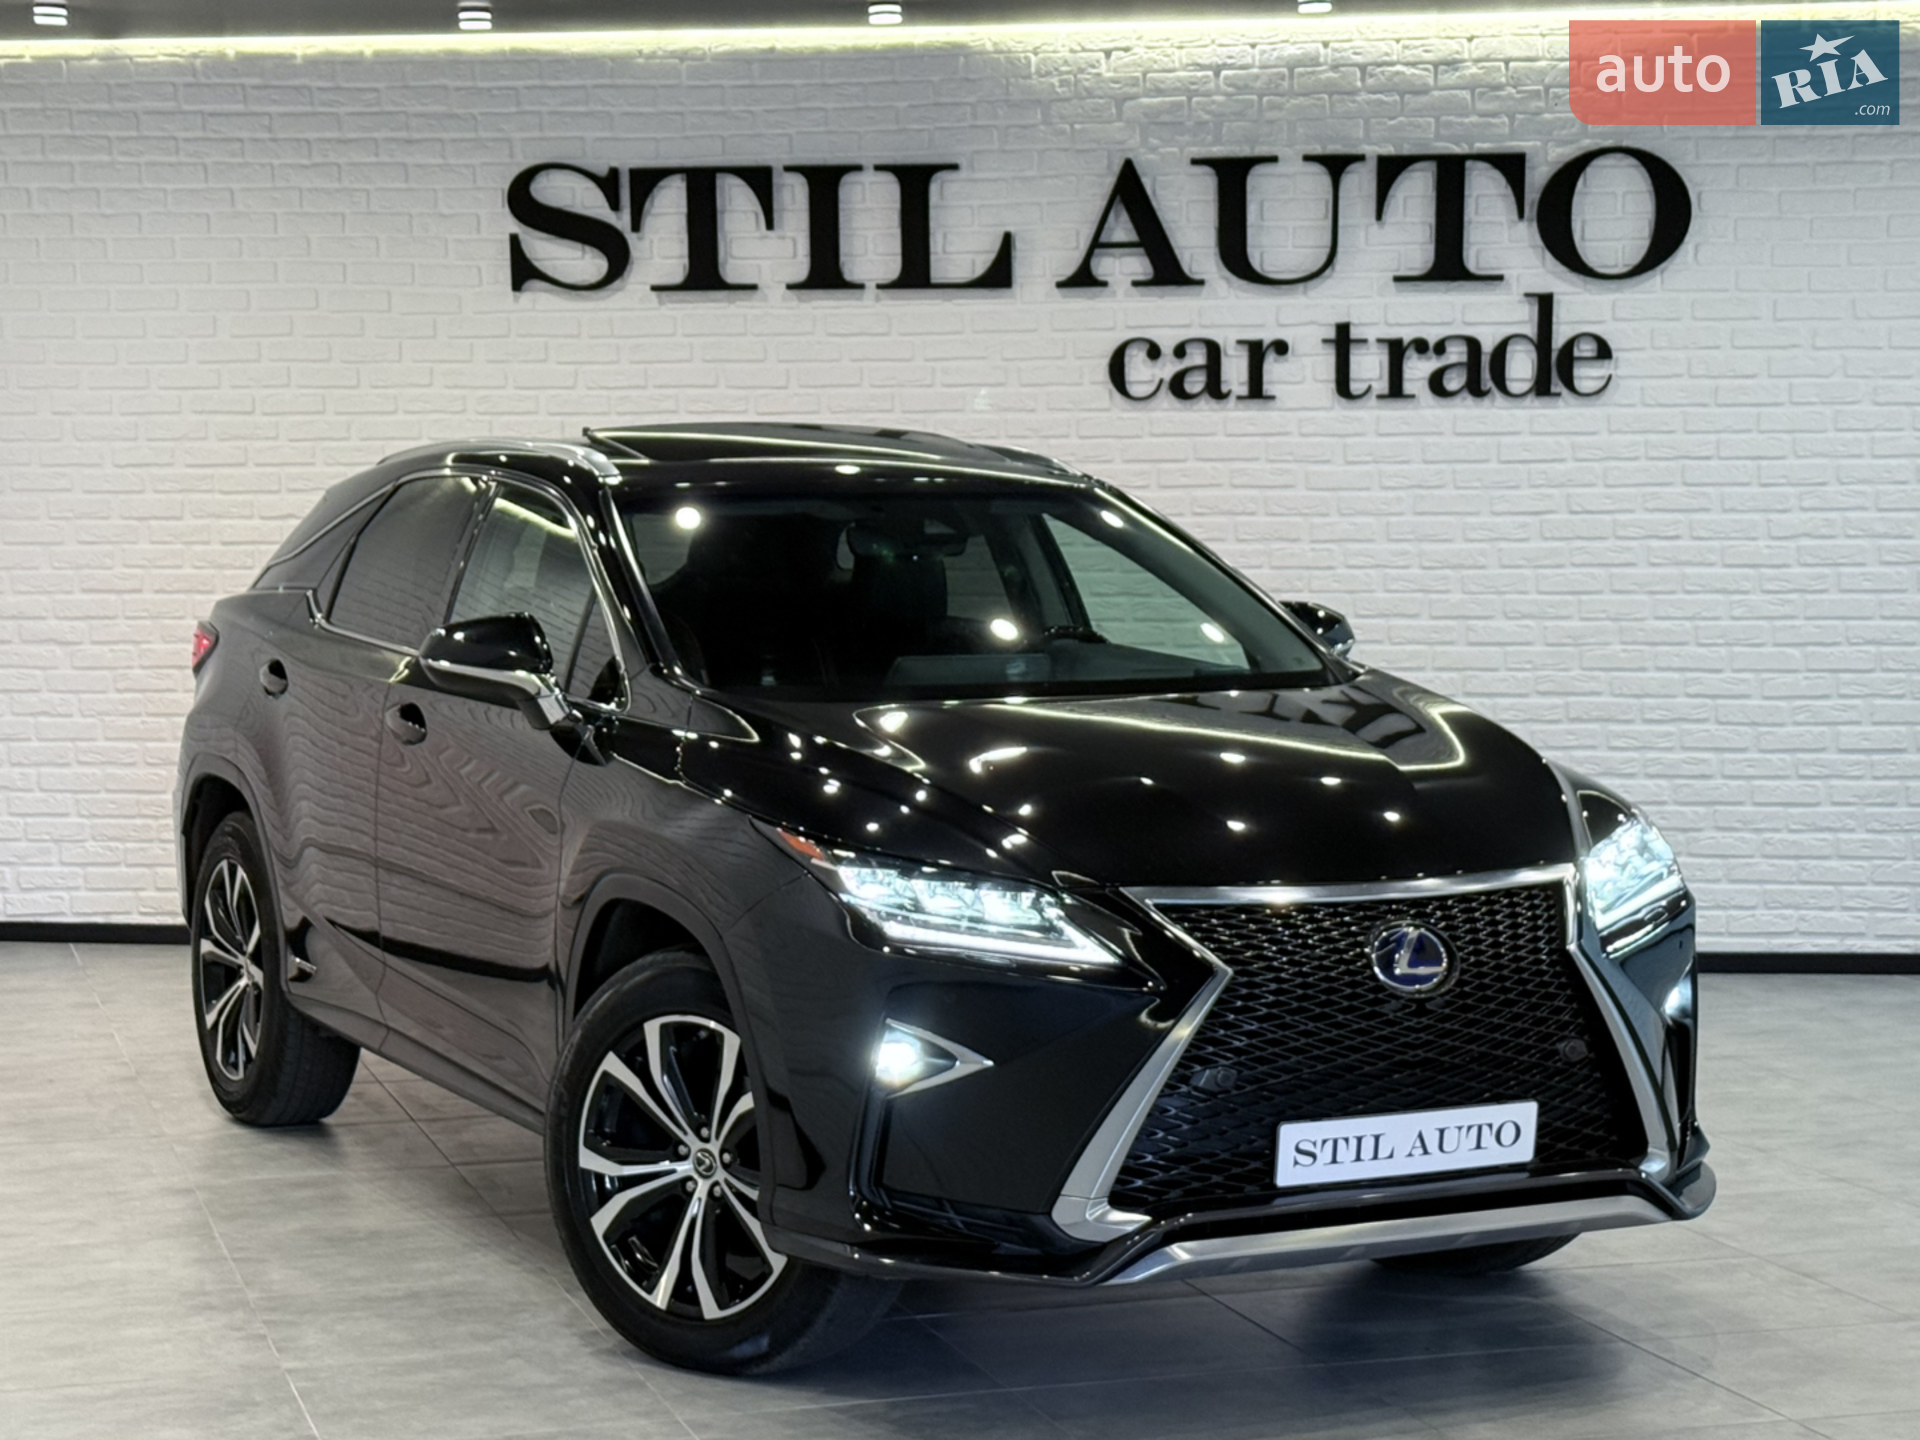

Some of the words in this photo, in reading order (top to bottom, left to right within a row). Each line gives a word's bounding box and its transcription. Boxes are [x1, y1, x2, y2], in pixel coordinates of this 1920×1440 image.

[507, 162, 1013, 292] STIL
[1055, 145, 1692, 288] AUTO
[1108, 336, 1289, 401] car
[1321, 292, 1613, 401] trade
[1292, 1132, 1396, 1169] STIL
[1404, 1119, 1522, 1159] AUTO
